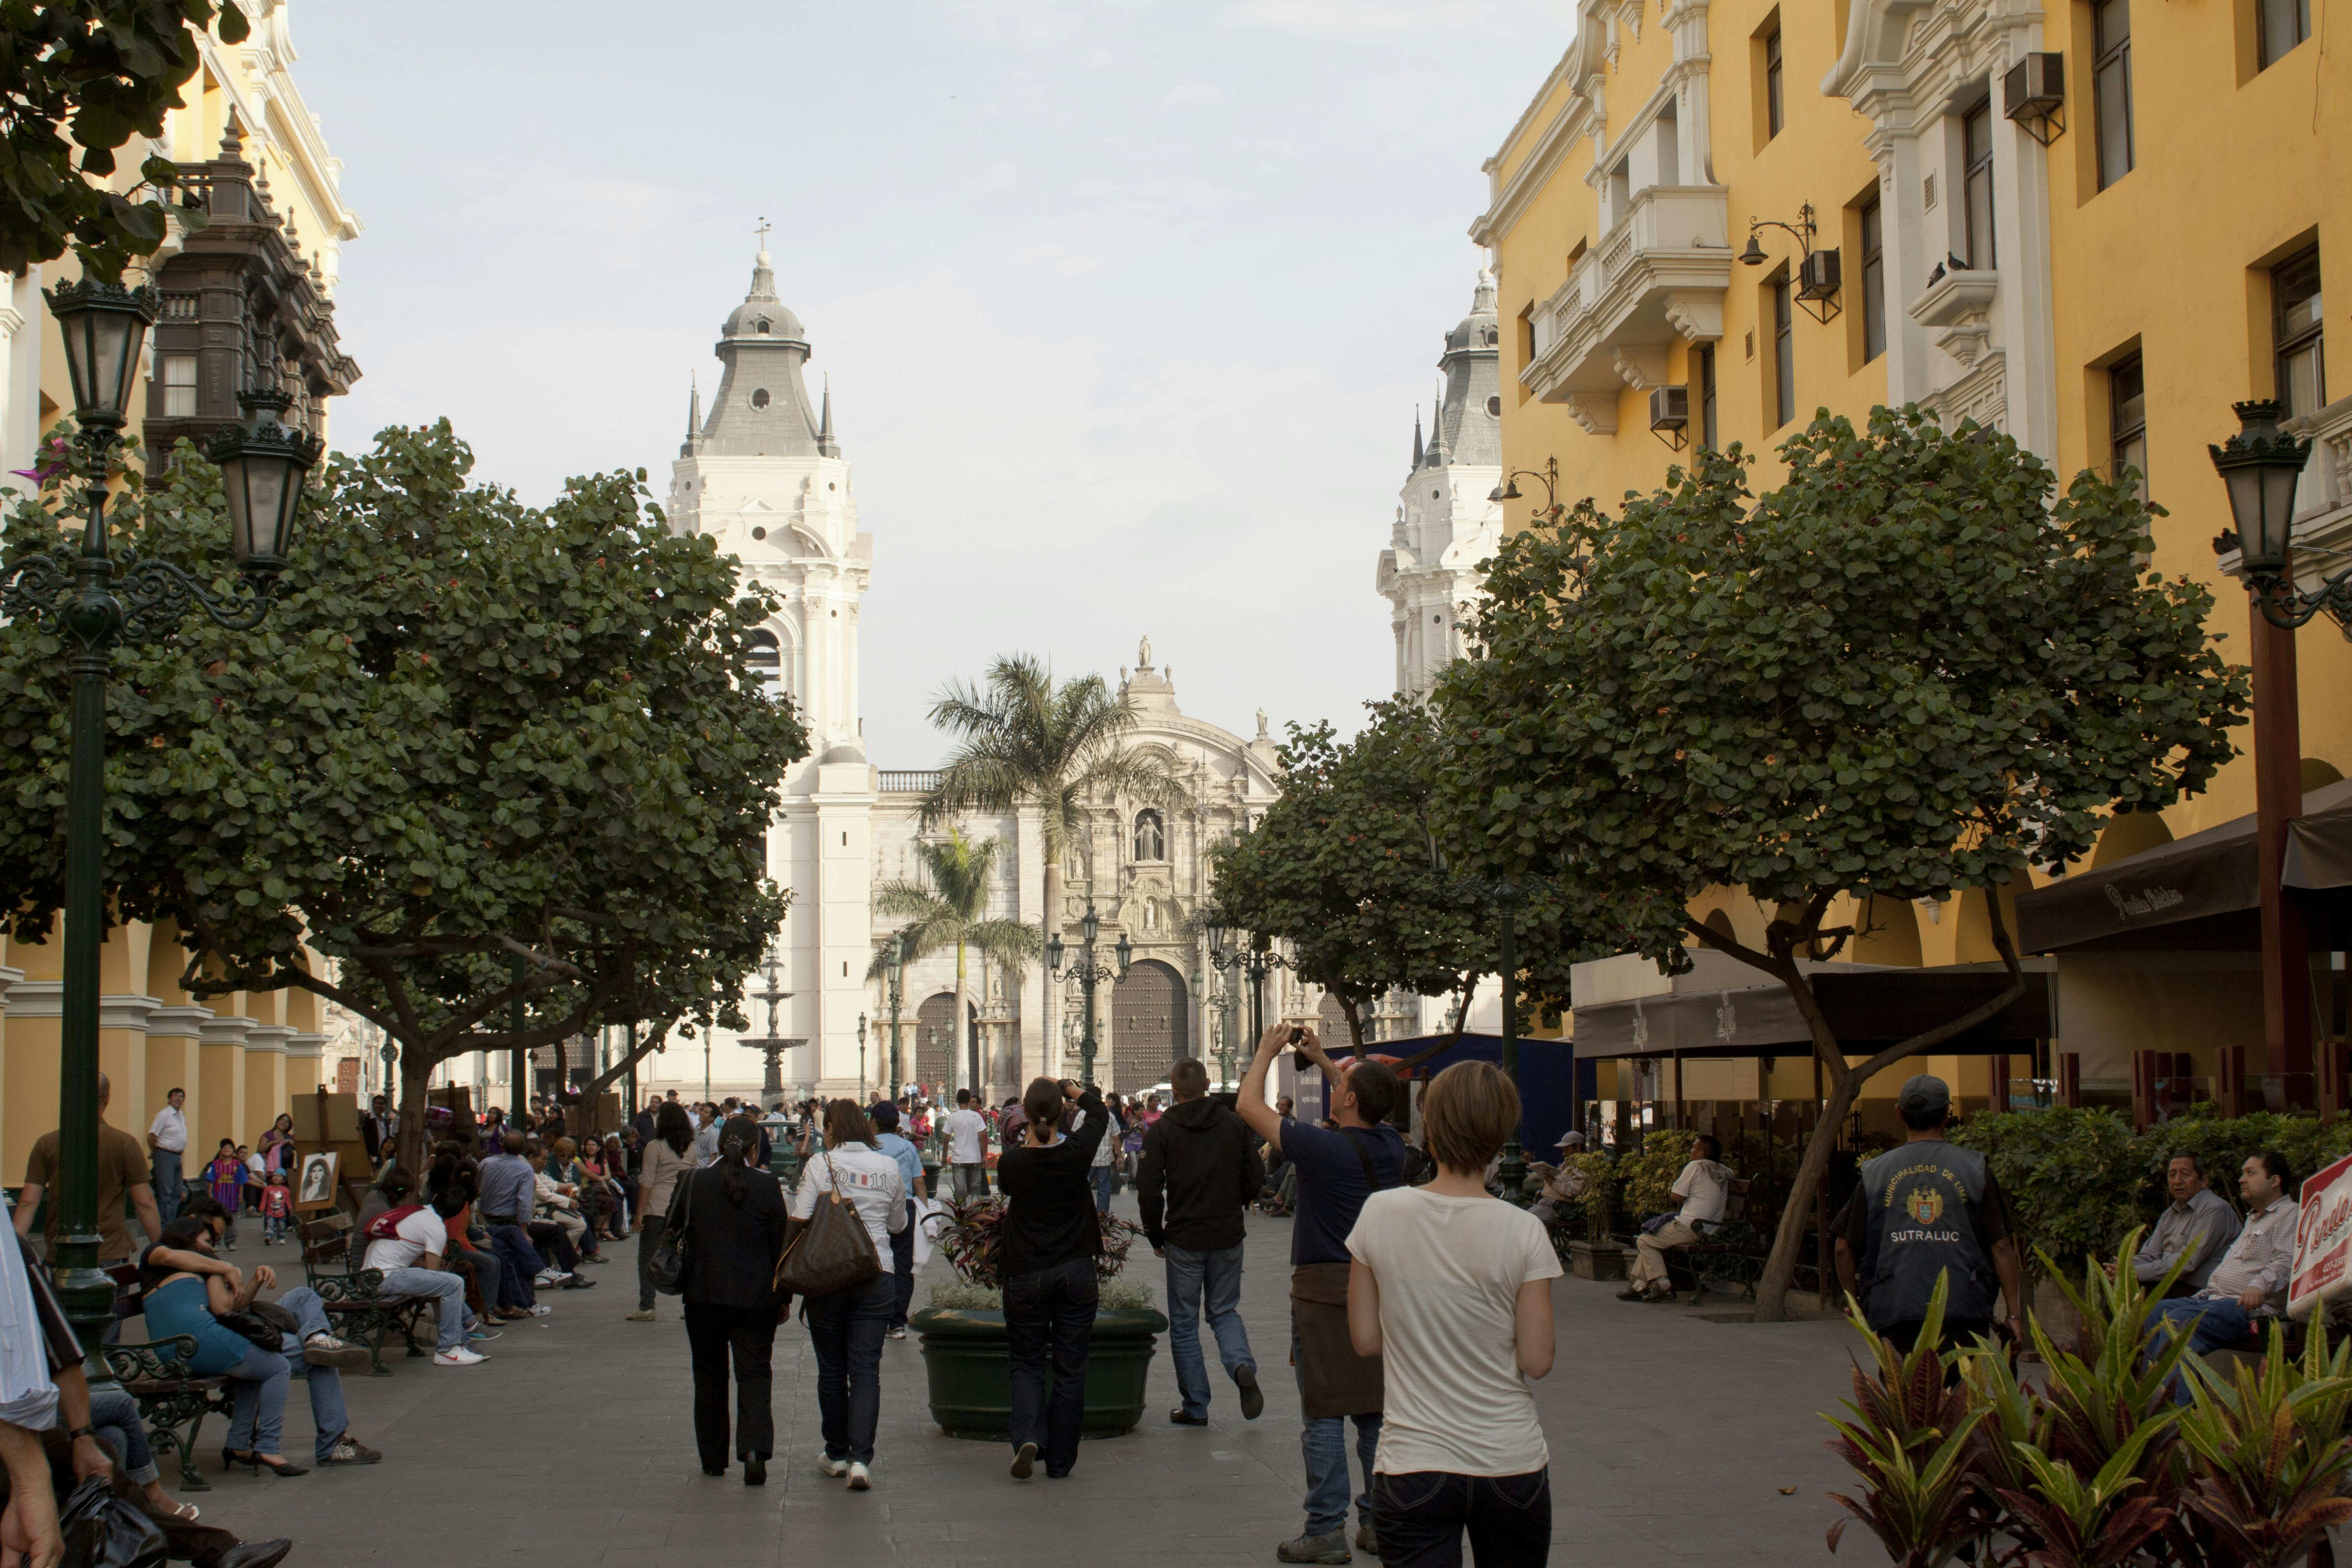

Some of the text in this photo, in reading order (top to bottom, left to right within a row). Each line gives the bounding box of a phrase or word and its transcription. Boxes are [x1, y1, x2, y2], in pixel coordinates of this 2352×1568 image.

[1884, 1165, 1968, 1208] MUNICIPALIDAD DE LIMA
[1891, 1230, 1960, 1242] SUTRALUC
[2323, 1254, 2347, 1273] 427-2301
